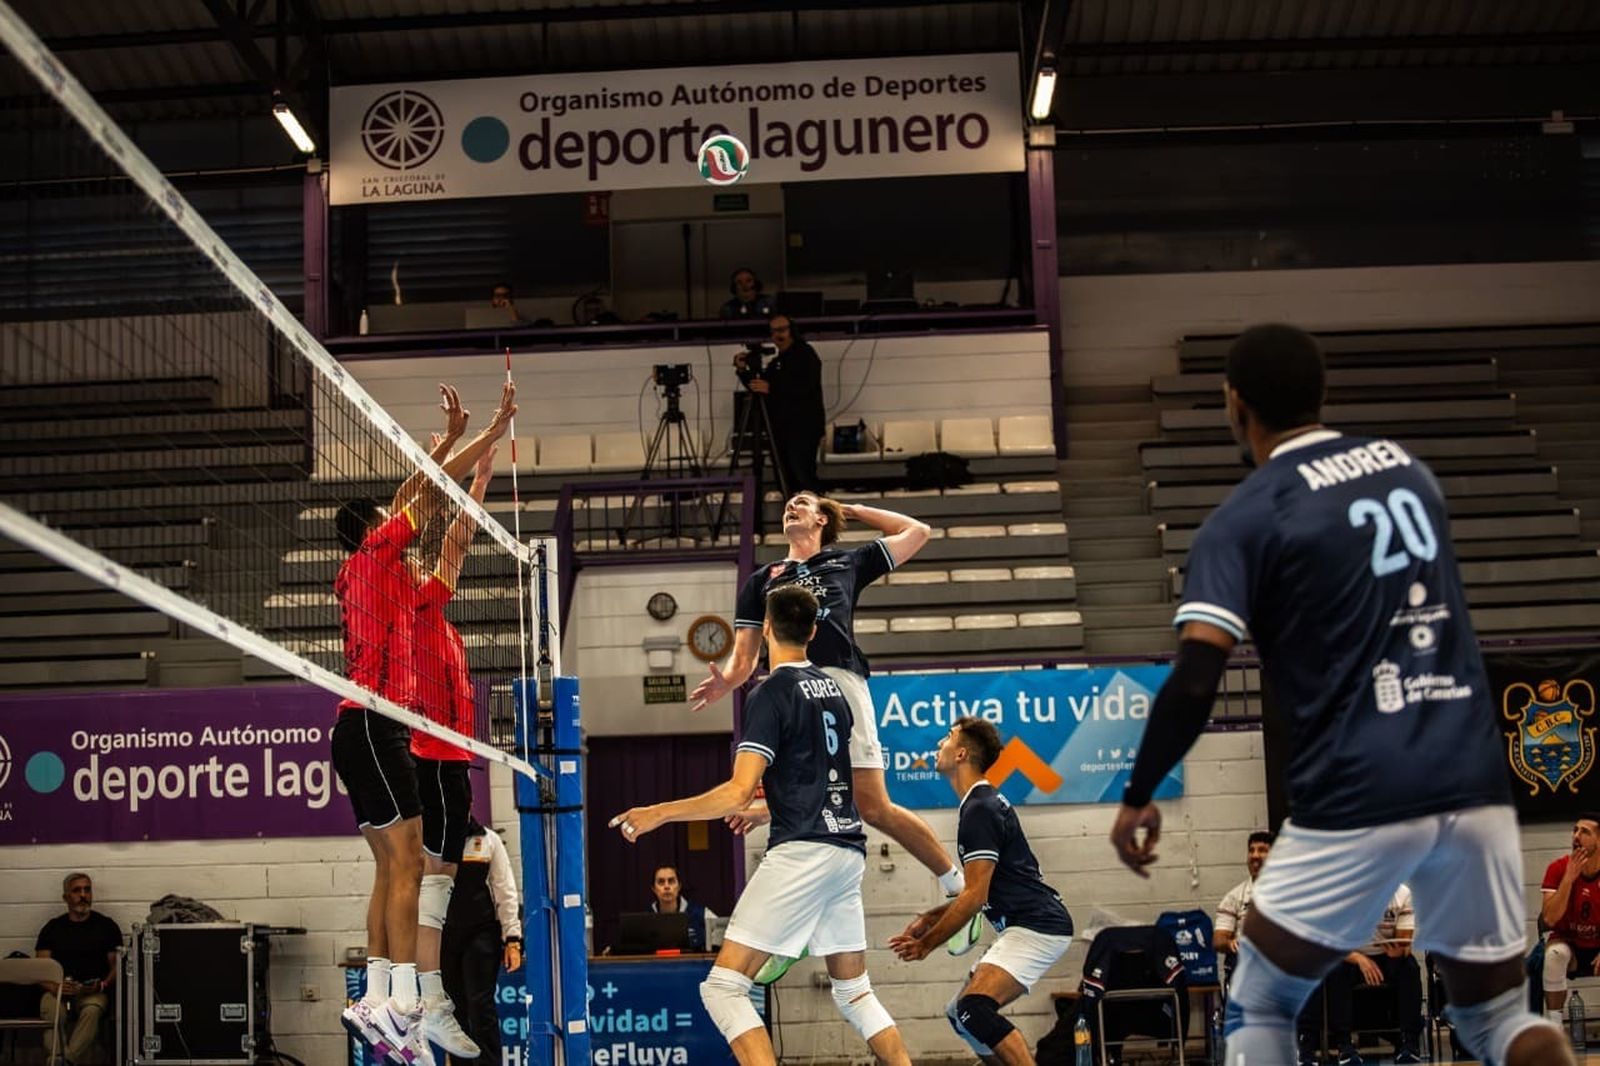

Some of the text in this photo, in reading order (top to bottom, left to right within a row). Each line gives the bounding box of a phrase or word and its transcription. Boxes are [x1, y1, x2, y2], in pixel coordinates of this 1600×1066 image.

[520, 73, 987, 116] Organismo Autónomo de Deportes
[748, 106, 990, 172] lagunero
[362, 182, 446, 197] LA LAGUNA
[1348, 487, 1438, 578] 20
[880, 685, 1150, 728] Activa tu vida
[71, 727, 193, 753] Organismo
[200, 724, 322, 747] Autónomo
[822, 711, 839, 756] 6
[72, 754, 249, 812] deporte
[896, 771, 941, 781] TENERIFE
